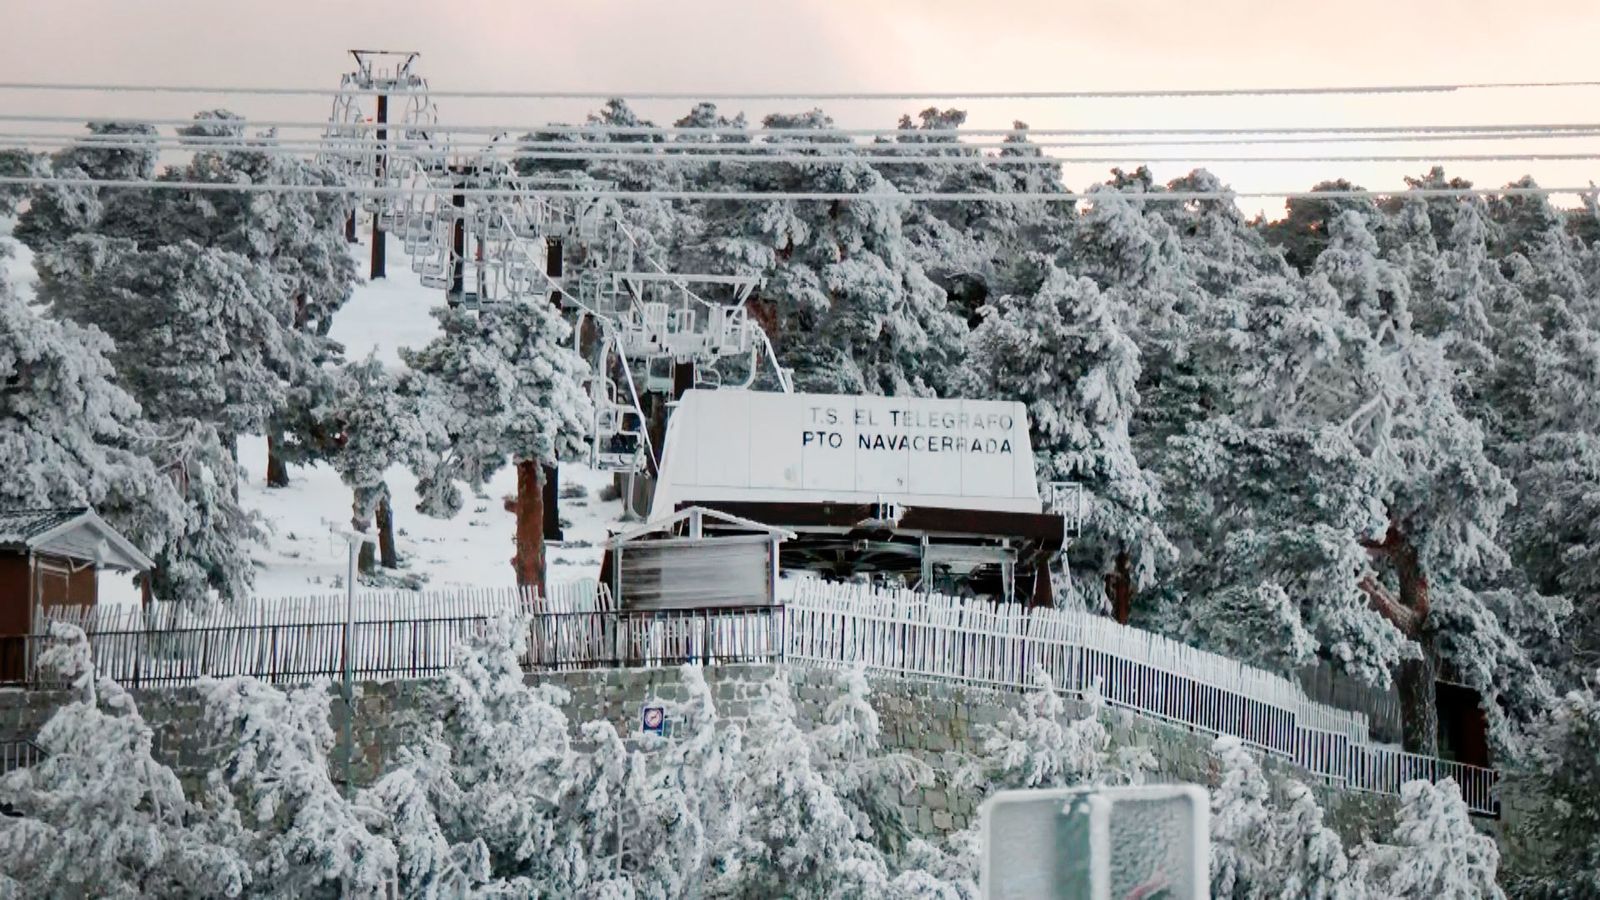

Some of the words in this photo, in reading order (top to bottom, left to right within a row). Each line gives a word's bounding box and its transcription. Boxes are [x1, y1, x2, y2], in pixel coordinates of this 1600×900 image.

[854, 409, 880, 427] EL
[889, 410, 1013, 431] TELEGRAFO
[802, 431, 843, 449] PTO
[858, 433, 1013, 455] NAVACERRADA
